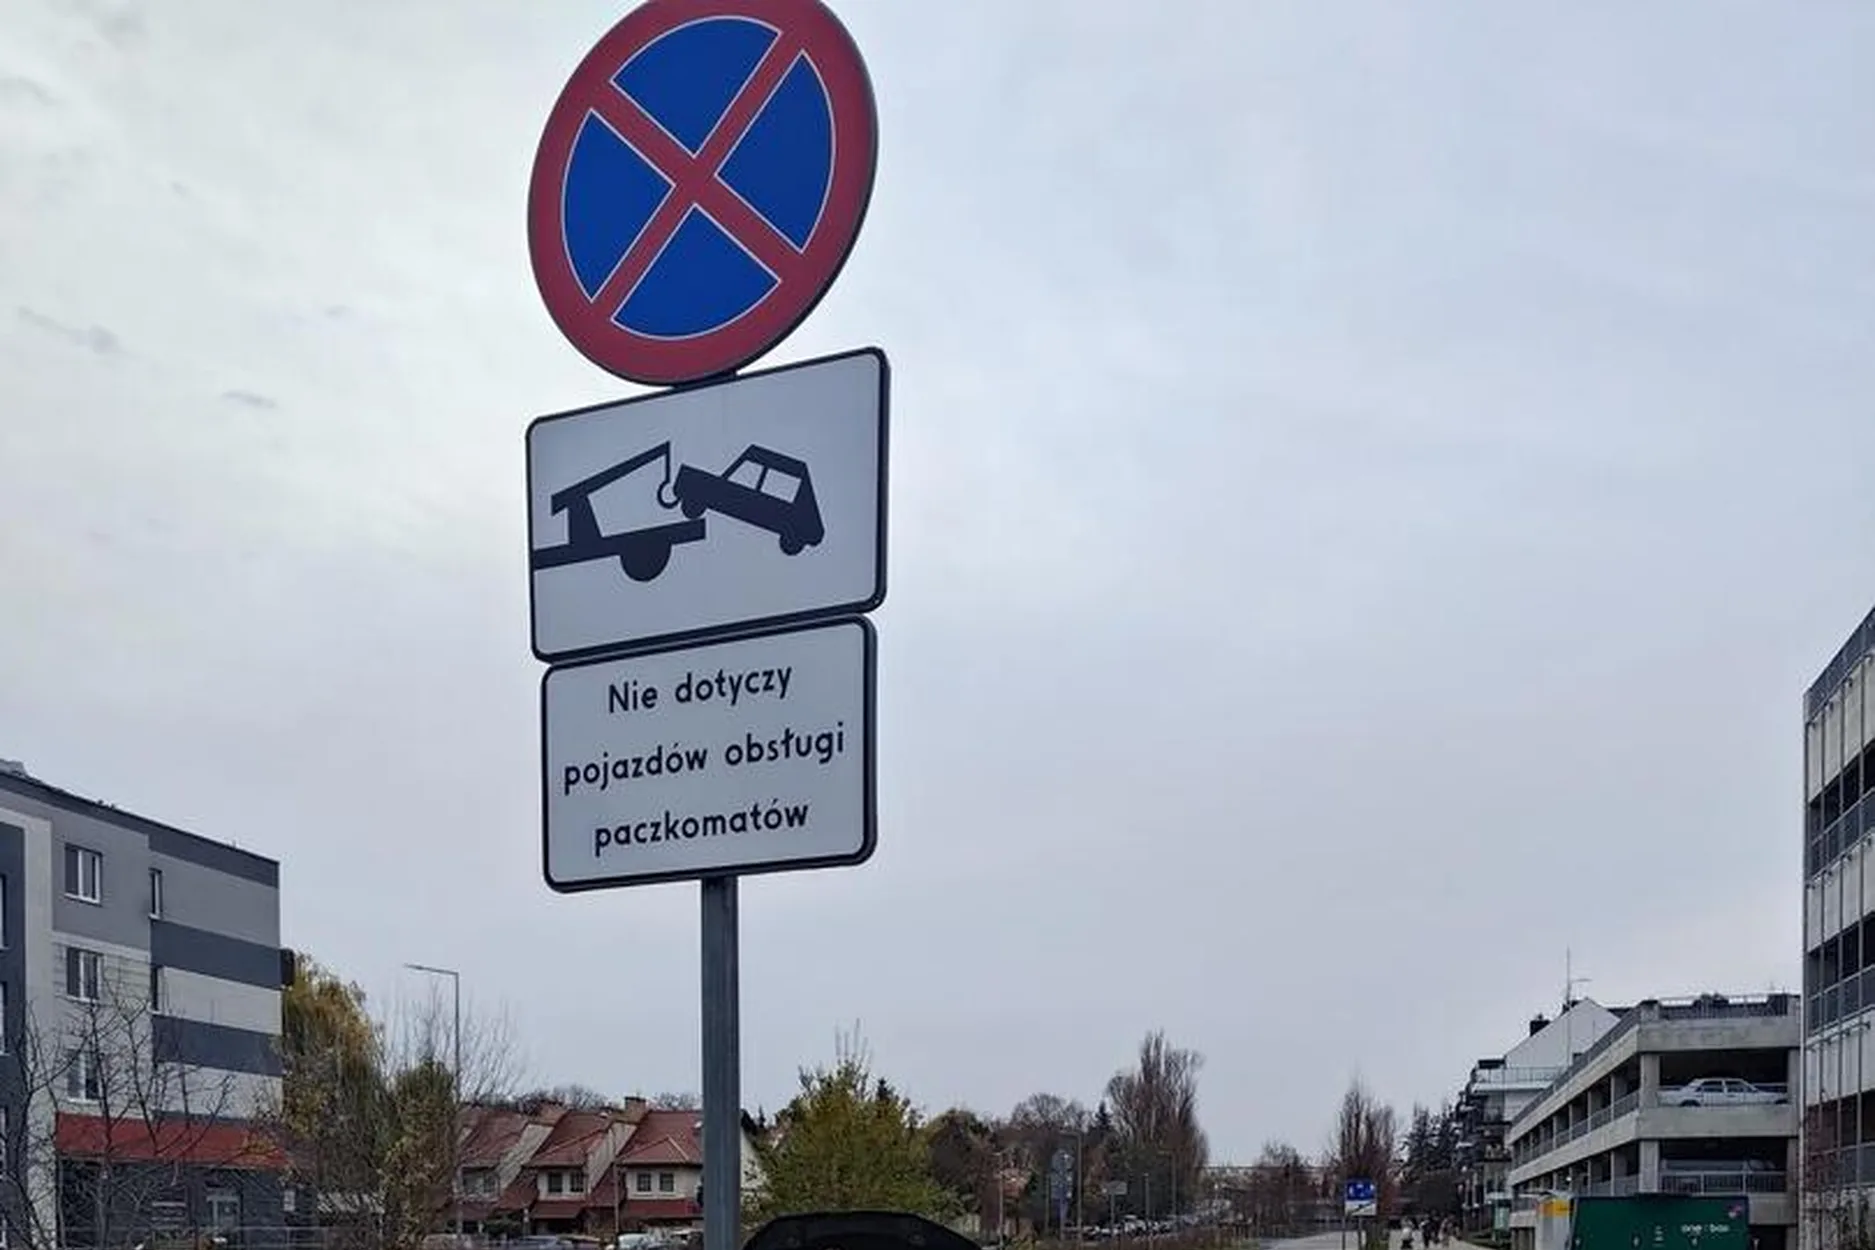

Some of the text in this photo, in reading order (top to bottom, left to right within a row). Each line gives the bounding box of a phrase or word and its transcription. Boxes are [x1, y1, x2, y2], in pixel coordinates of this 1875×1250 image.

[608, 666, 793, 714] Nie dotyczy
[563, 721, 845, 797] pojazdów obsługi
[594, 798, 809, 858] paczkomatów
